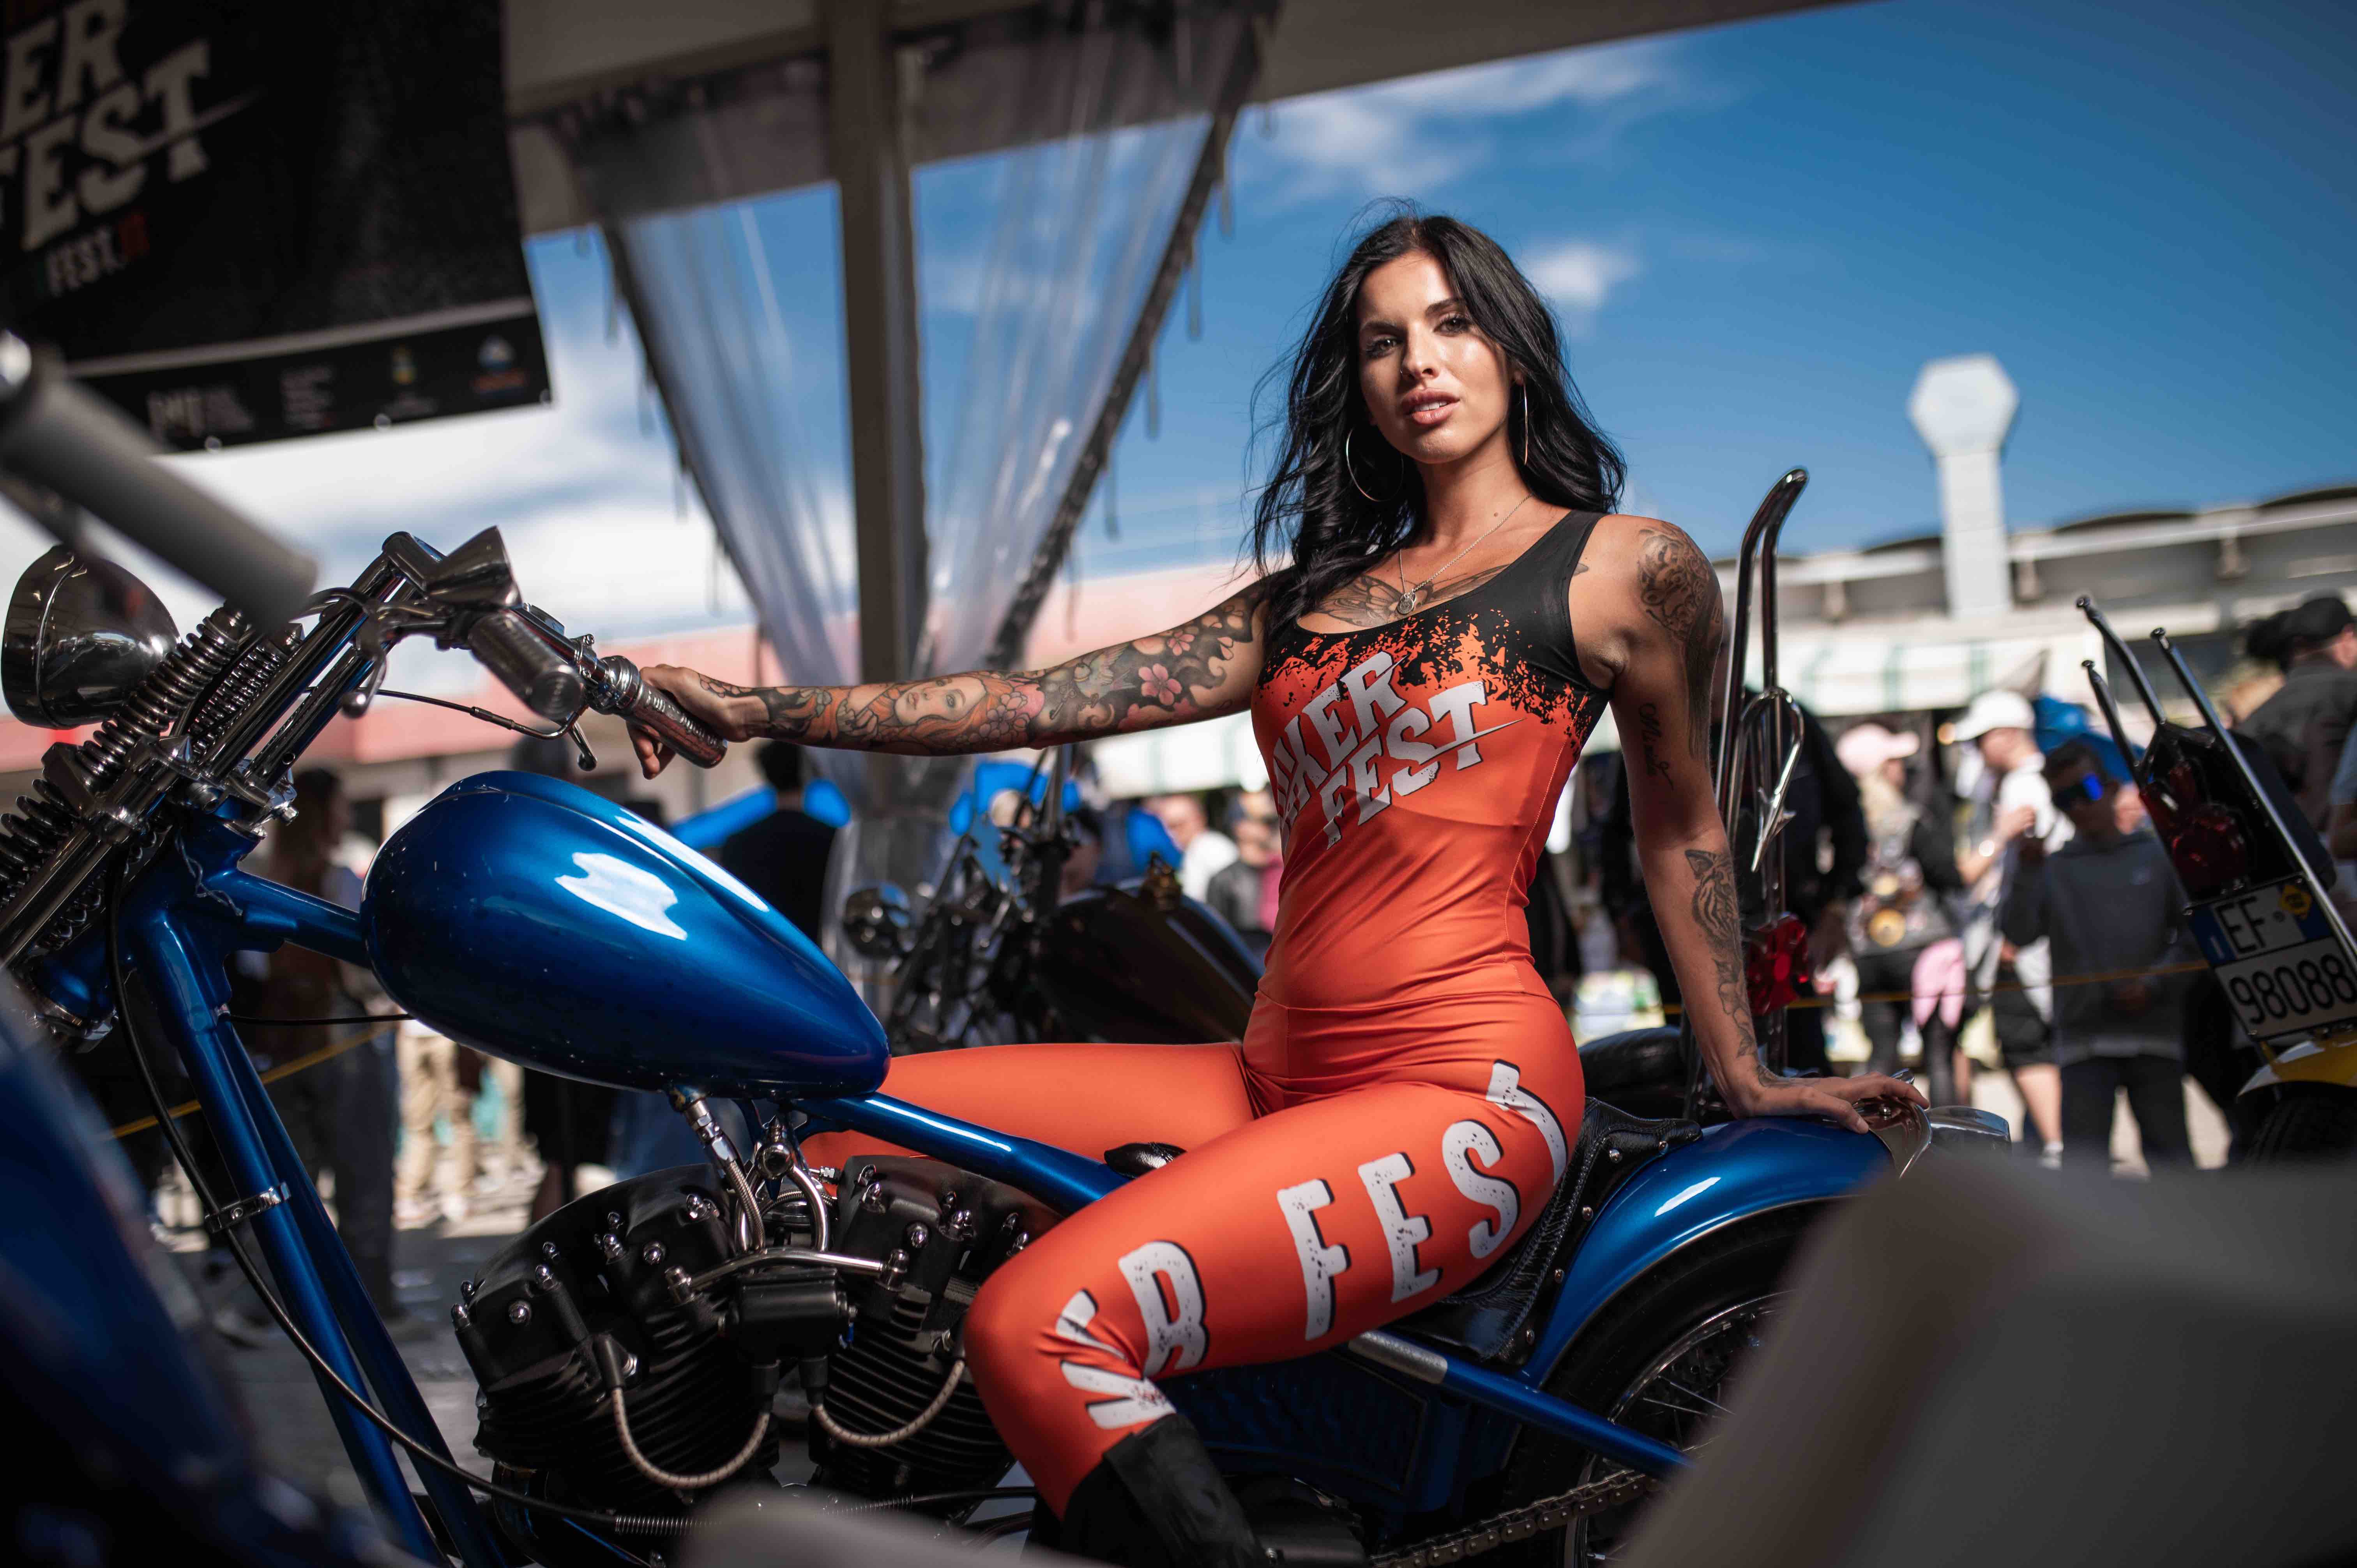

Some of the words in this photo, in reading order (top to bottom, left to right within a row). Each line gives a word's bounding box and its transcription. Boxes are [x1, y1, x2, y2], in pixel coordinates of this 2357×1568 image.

[1319, 680, 1487, 850] FEST
[2214, 896, 2266, 954] EF
[2229, 954, 2357, 1024] 98088
[1276, 1059, 1568, 1342] FEST
